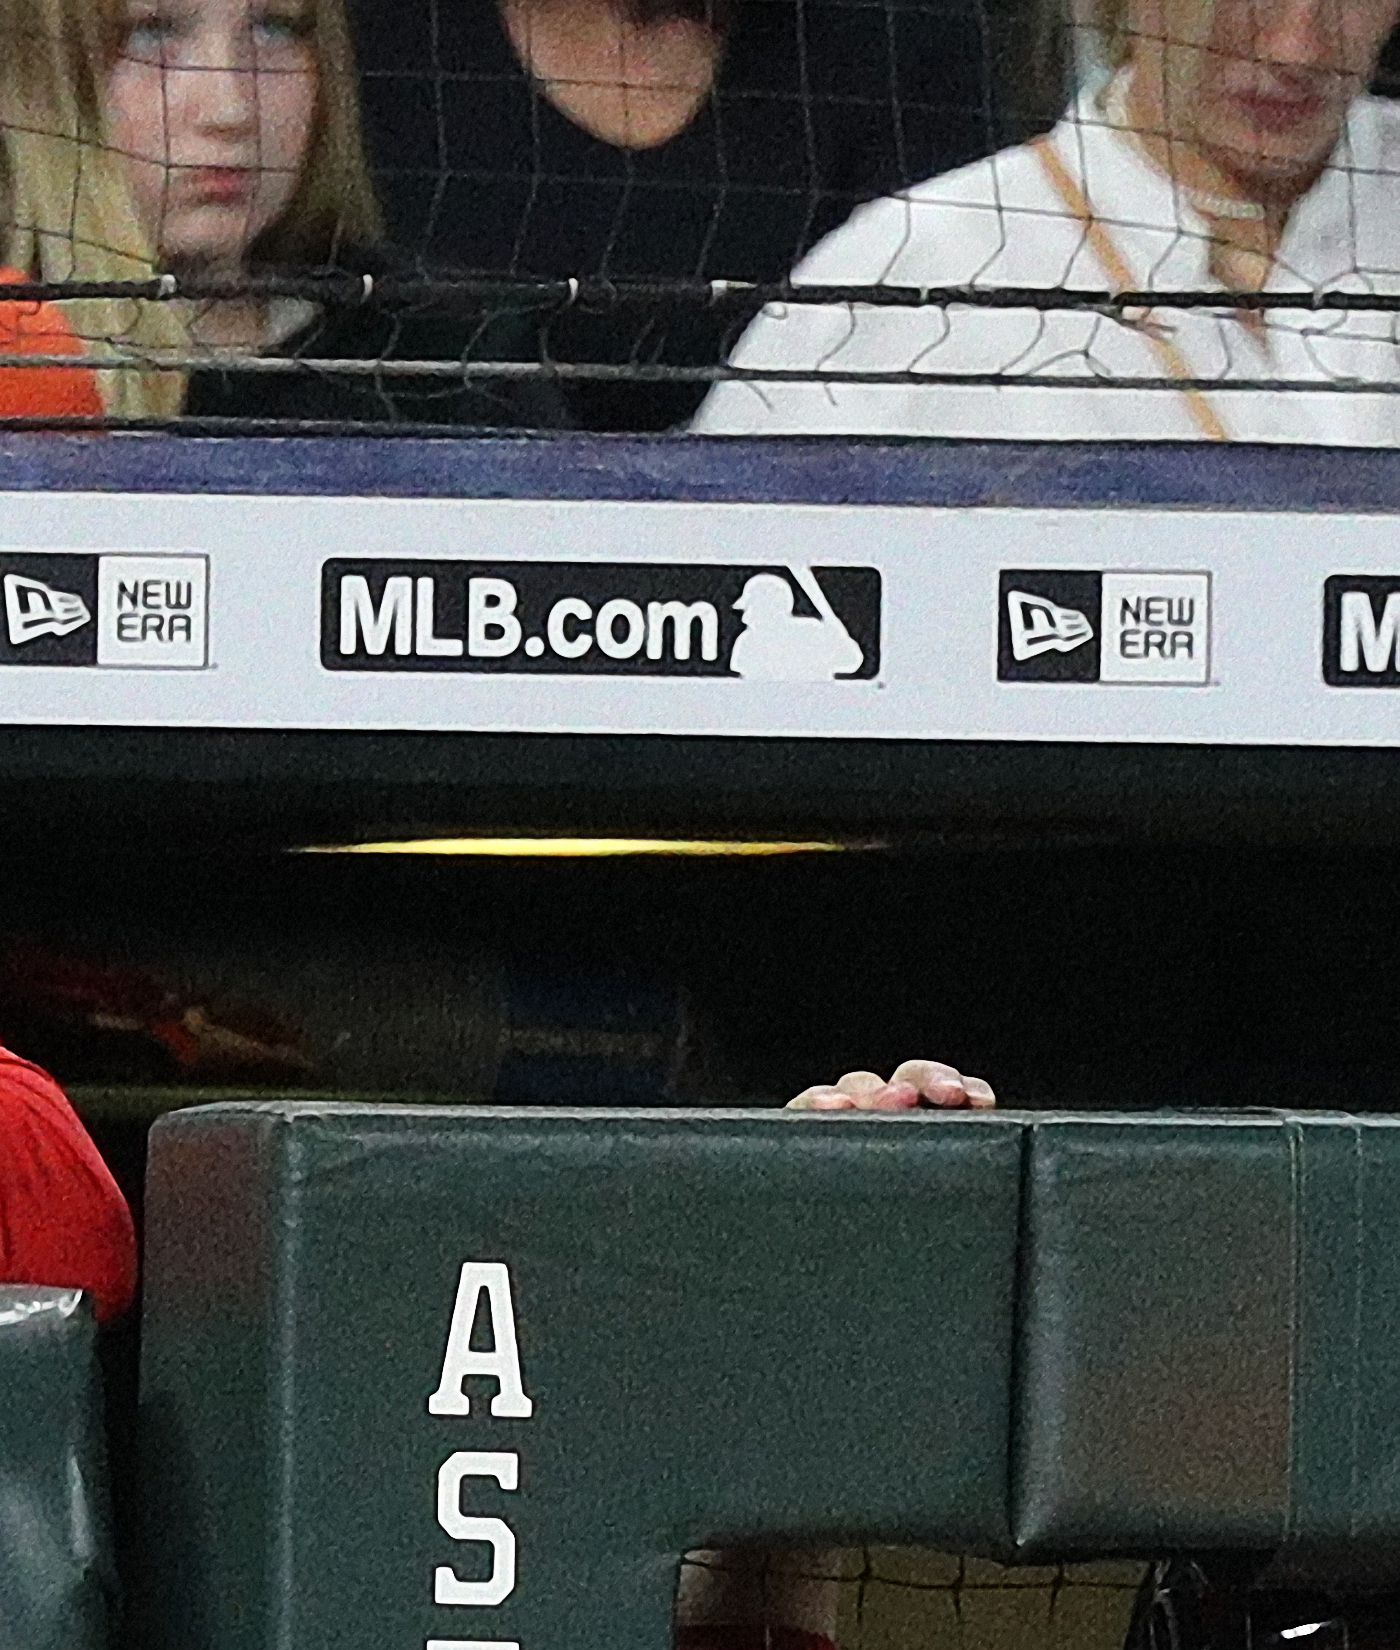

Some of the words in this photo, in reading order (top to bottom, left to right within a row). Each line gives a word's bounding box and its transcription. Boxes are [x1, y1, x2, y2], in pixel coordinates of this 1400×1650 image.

[117, 579, 192, 610] NEW
[116, 612, 192, 642] ERA
[340, 574, 718, 661] MLB.com
[1120, 596, 1195, 627] NEW
[1119, 628, 1194, 659] ERA
